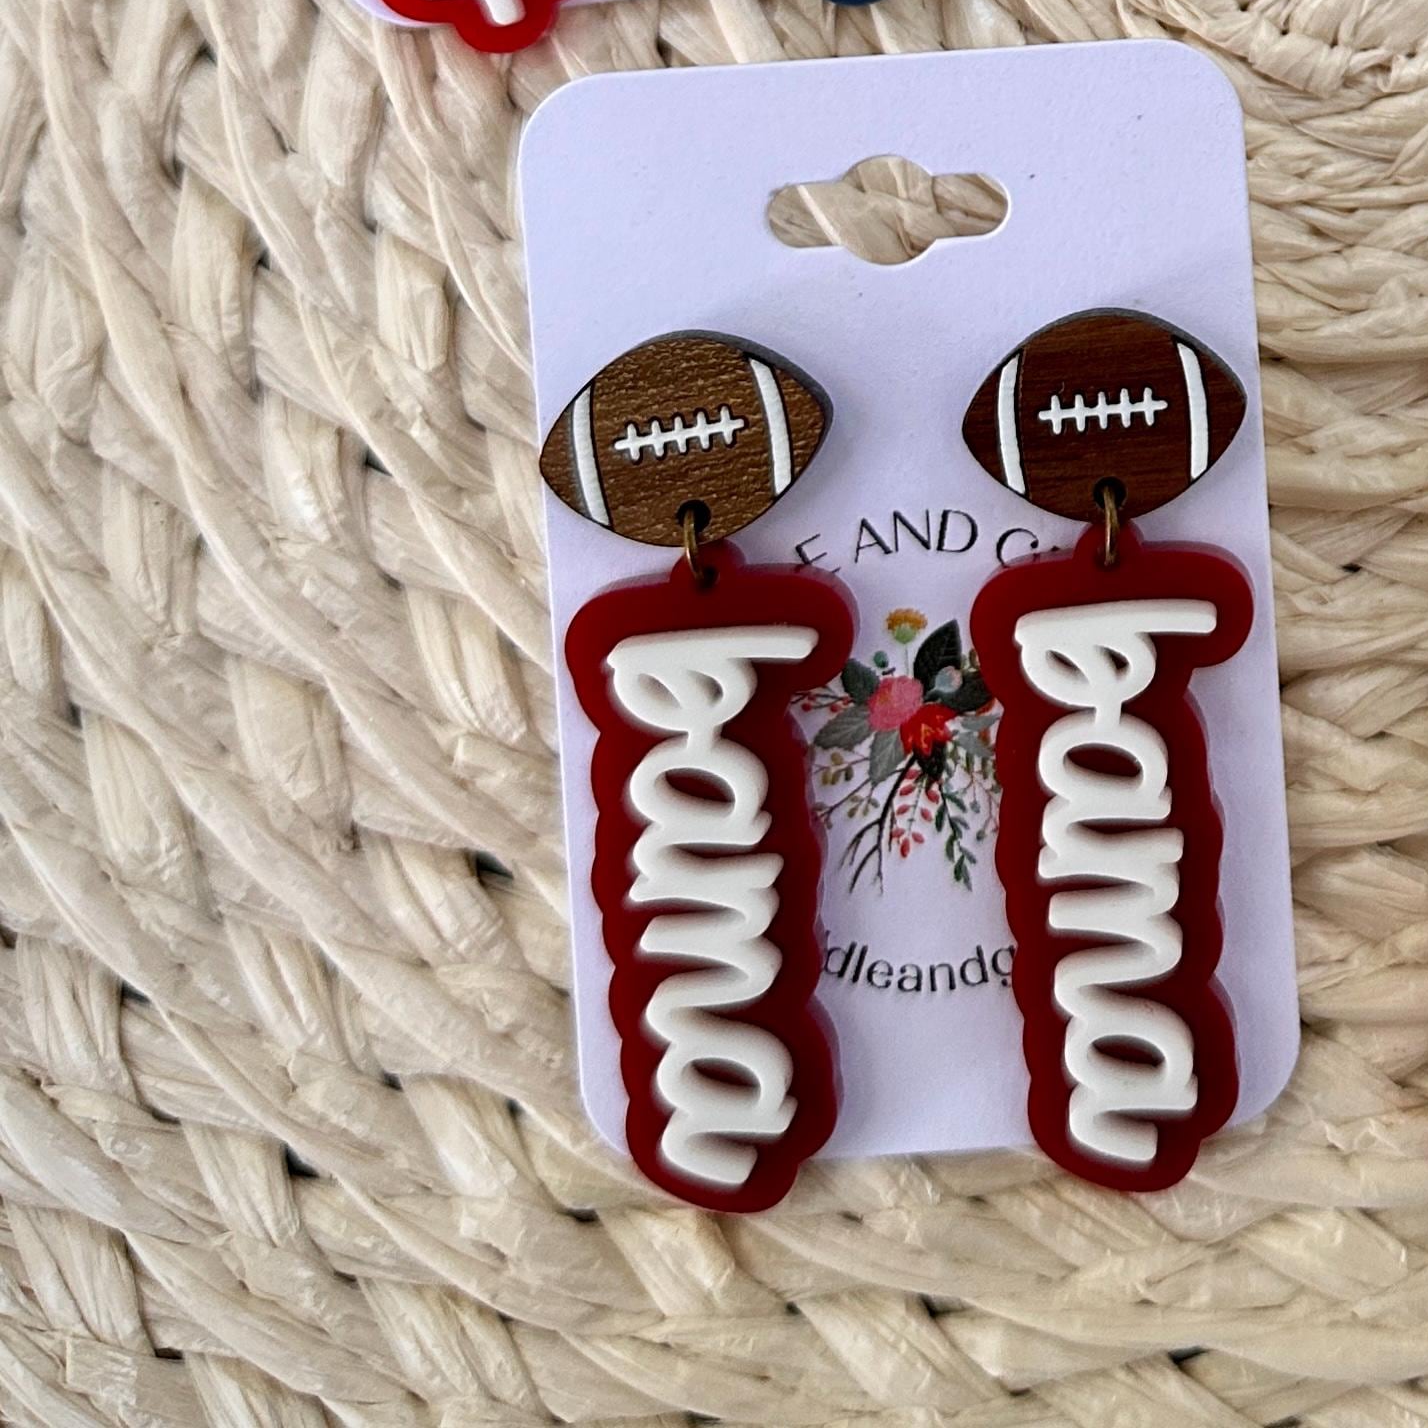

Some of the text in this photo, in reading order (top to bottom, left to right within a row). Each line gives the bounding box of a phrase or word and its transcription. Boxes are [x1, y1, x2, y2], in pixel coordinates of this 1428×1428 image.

[855, 509, 978, 563] AND
[608, 624, 817, 1186] bama
[1014, 598, 1217, 1165] bama
